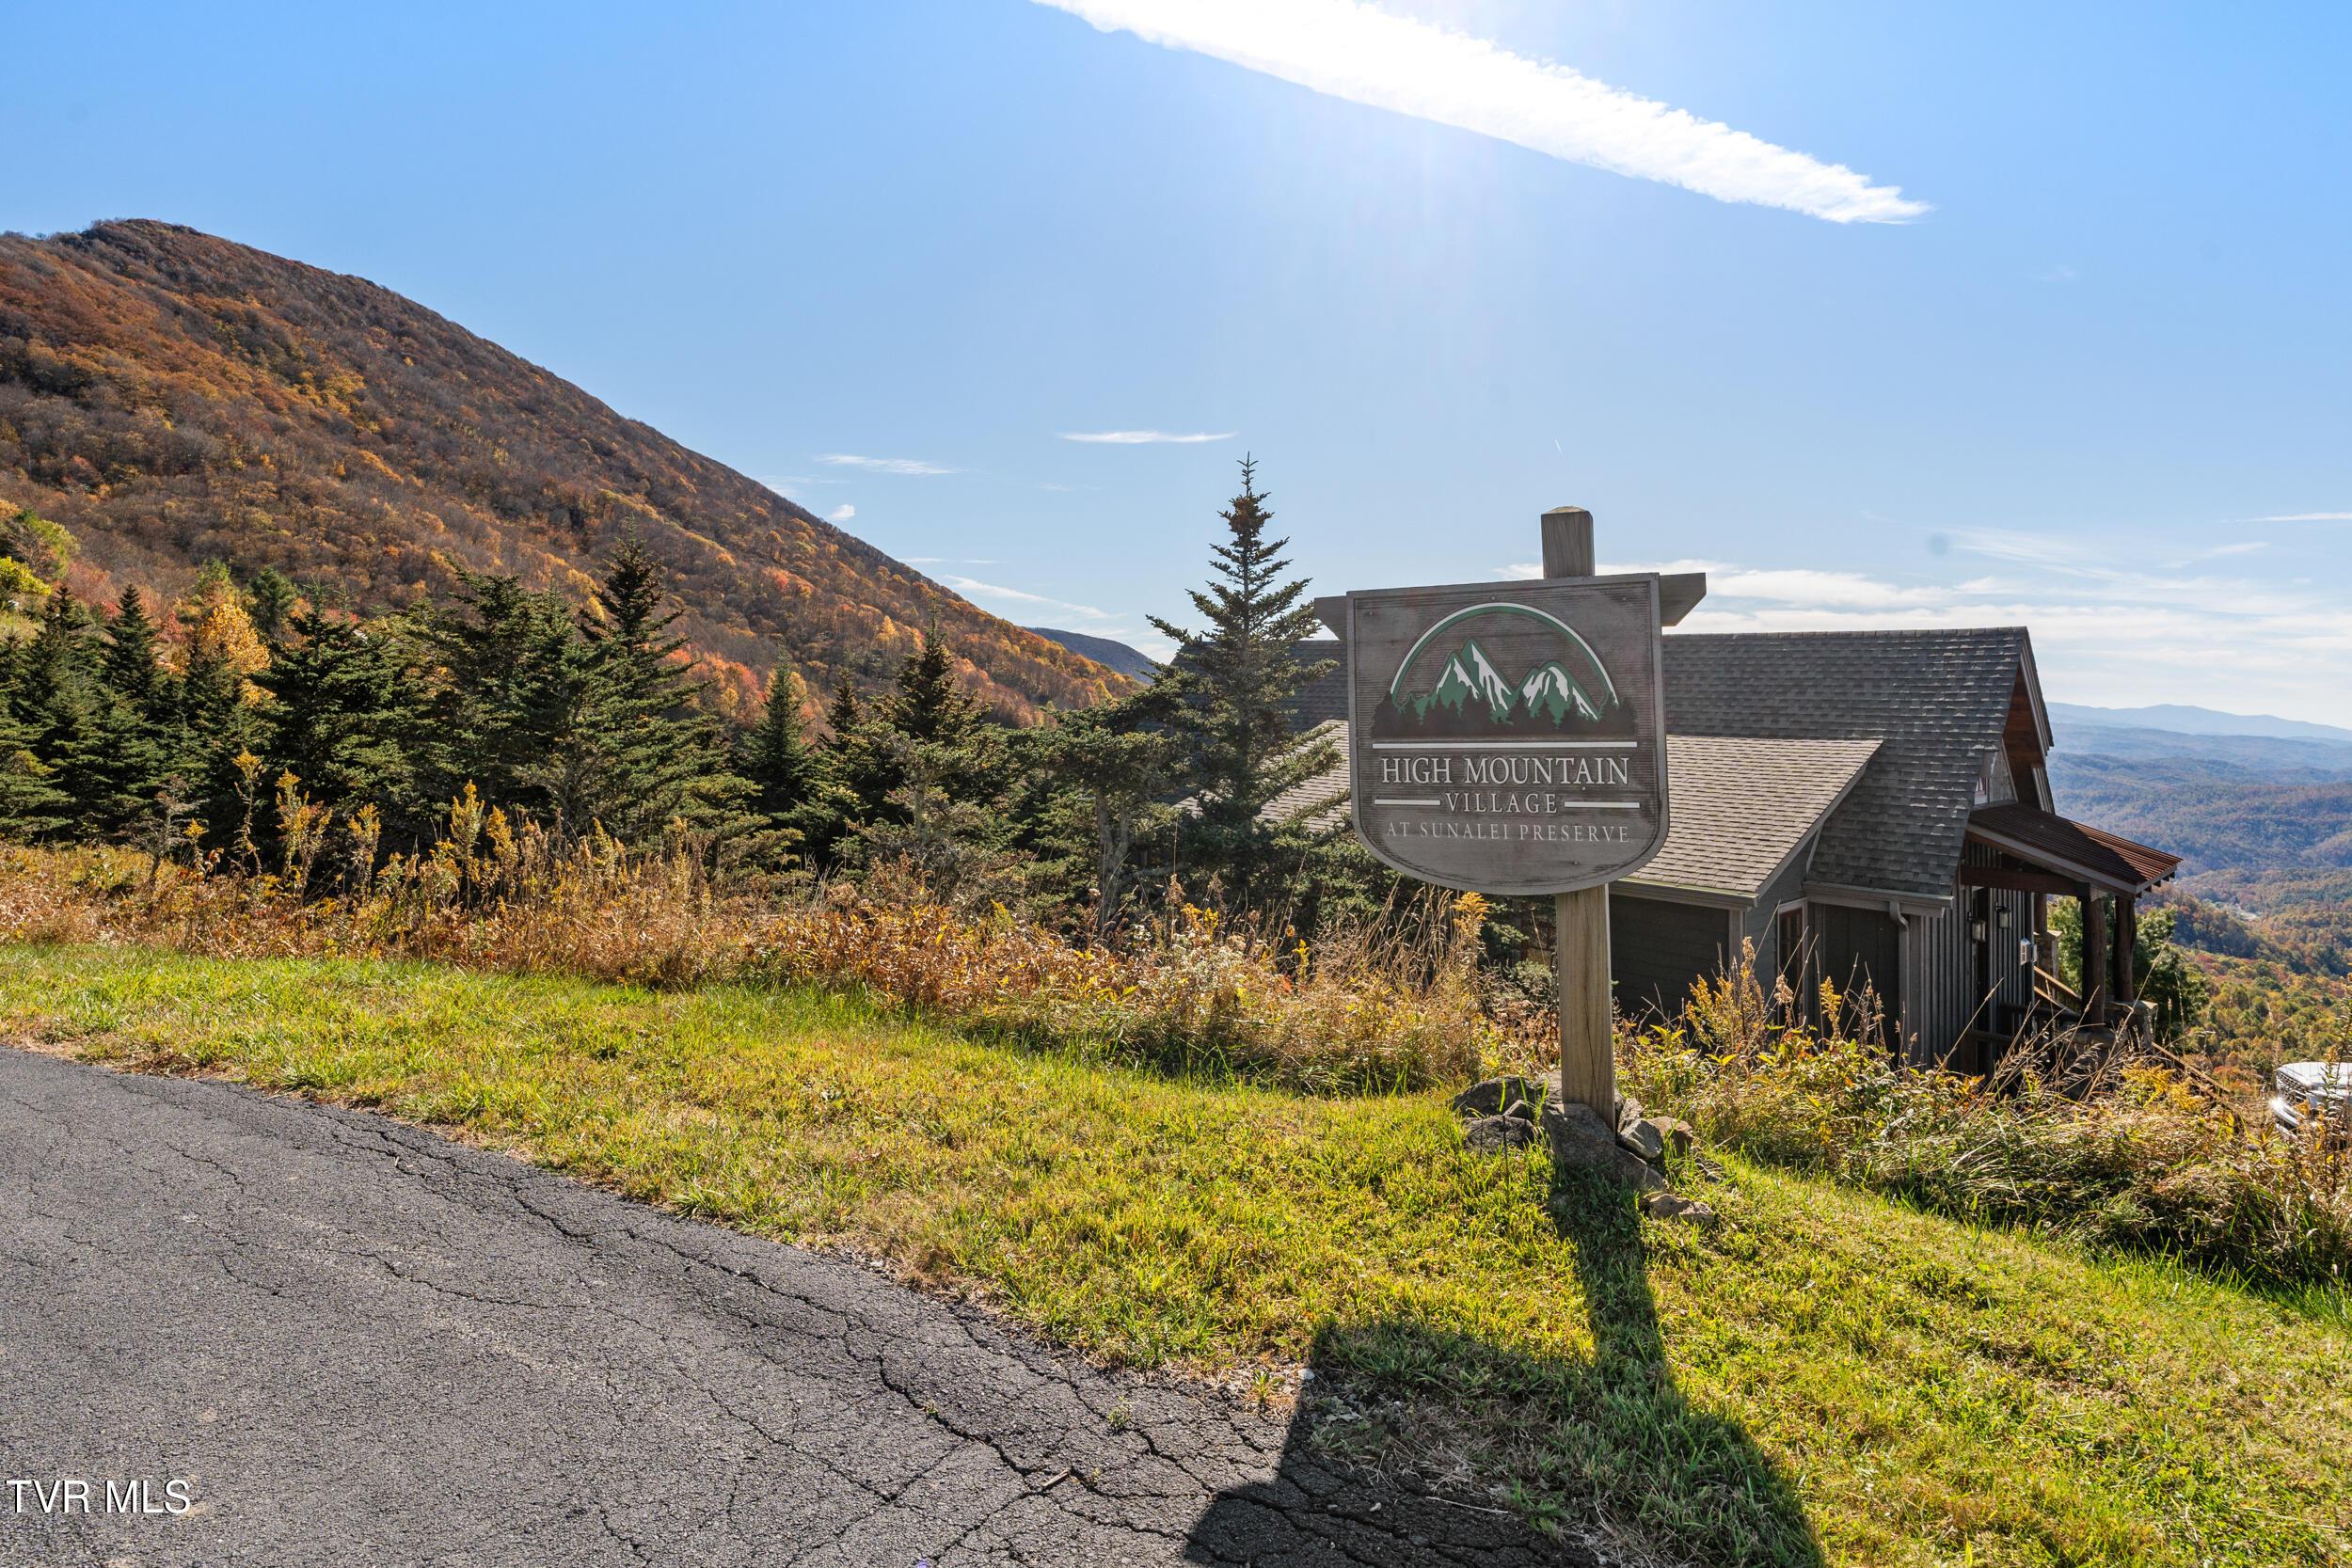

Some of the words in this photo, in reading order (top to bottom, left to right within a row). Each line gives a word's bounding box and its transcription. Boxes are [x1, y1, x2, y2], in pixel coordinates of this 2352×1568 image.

[1381, 757, 1452, 784] HIGH
[1464, 757, 1629, 784] MOUNTAIN
[1445, 793, 1557, 814] VILLAGE
[1387, 822, 1410, 837] AT
[1420, 822, 1510, 839] SUNALEI
[1519, 825, 1629, 843] PRESERVE
